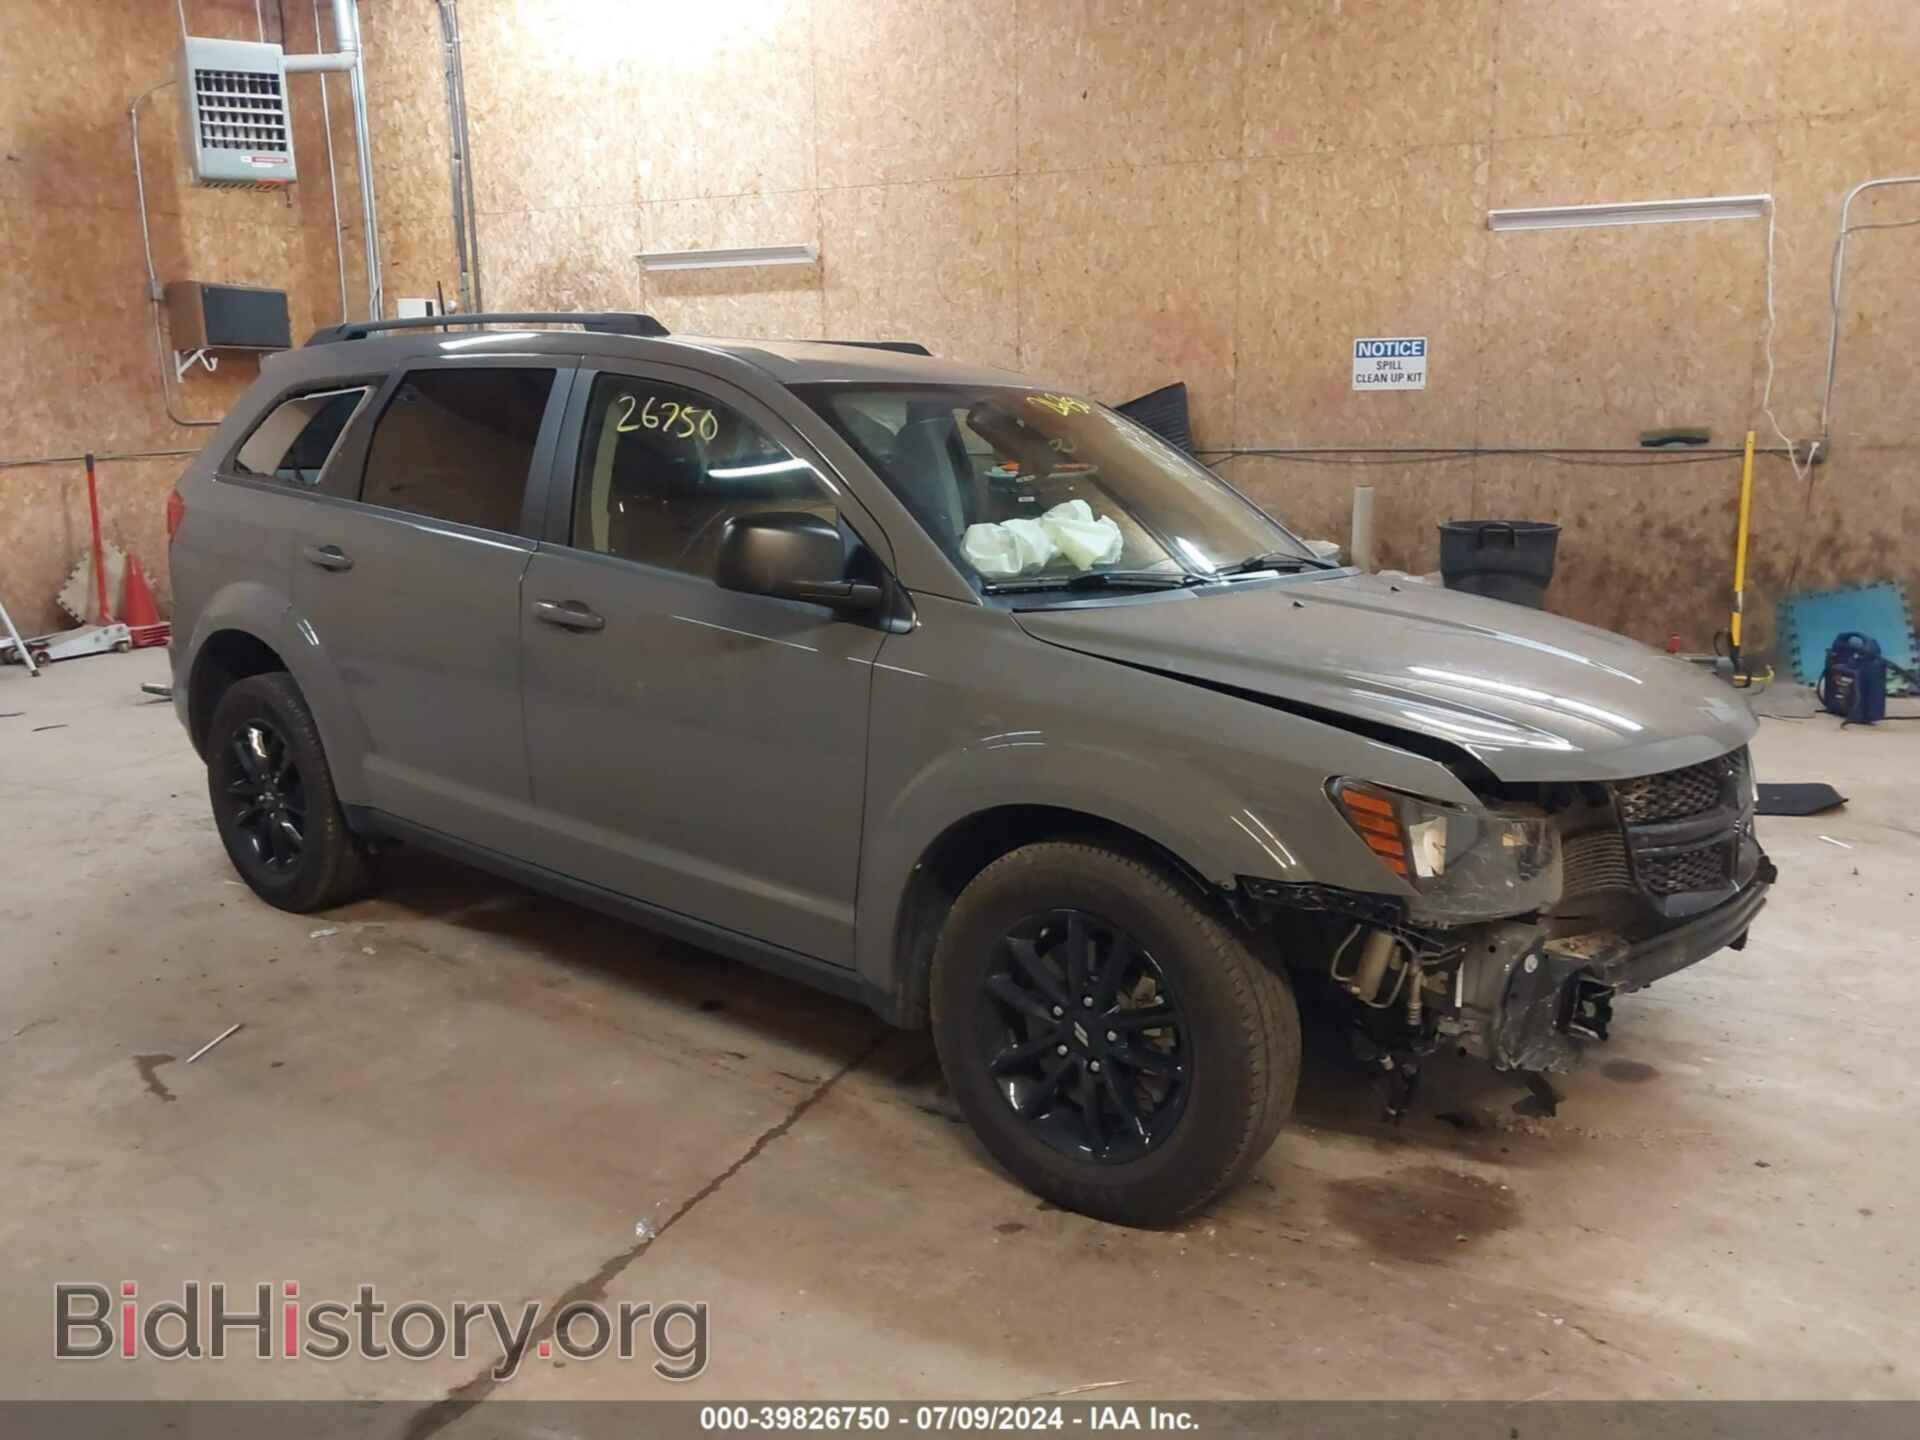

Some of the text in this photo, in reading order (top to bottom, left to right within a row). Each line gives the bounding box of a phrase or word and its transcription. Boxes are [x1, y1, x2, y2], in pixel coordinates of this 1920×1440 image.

[1358, 341, 1422, 356] NOTICE
[1376, 360, 1403, 370] SPILL
[1356, 372, 1422, 383] CLEAN UP KIT
[617, 395, 718, 441] 26750
